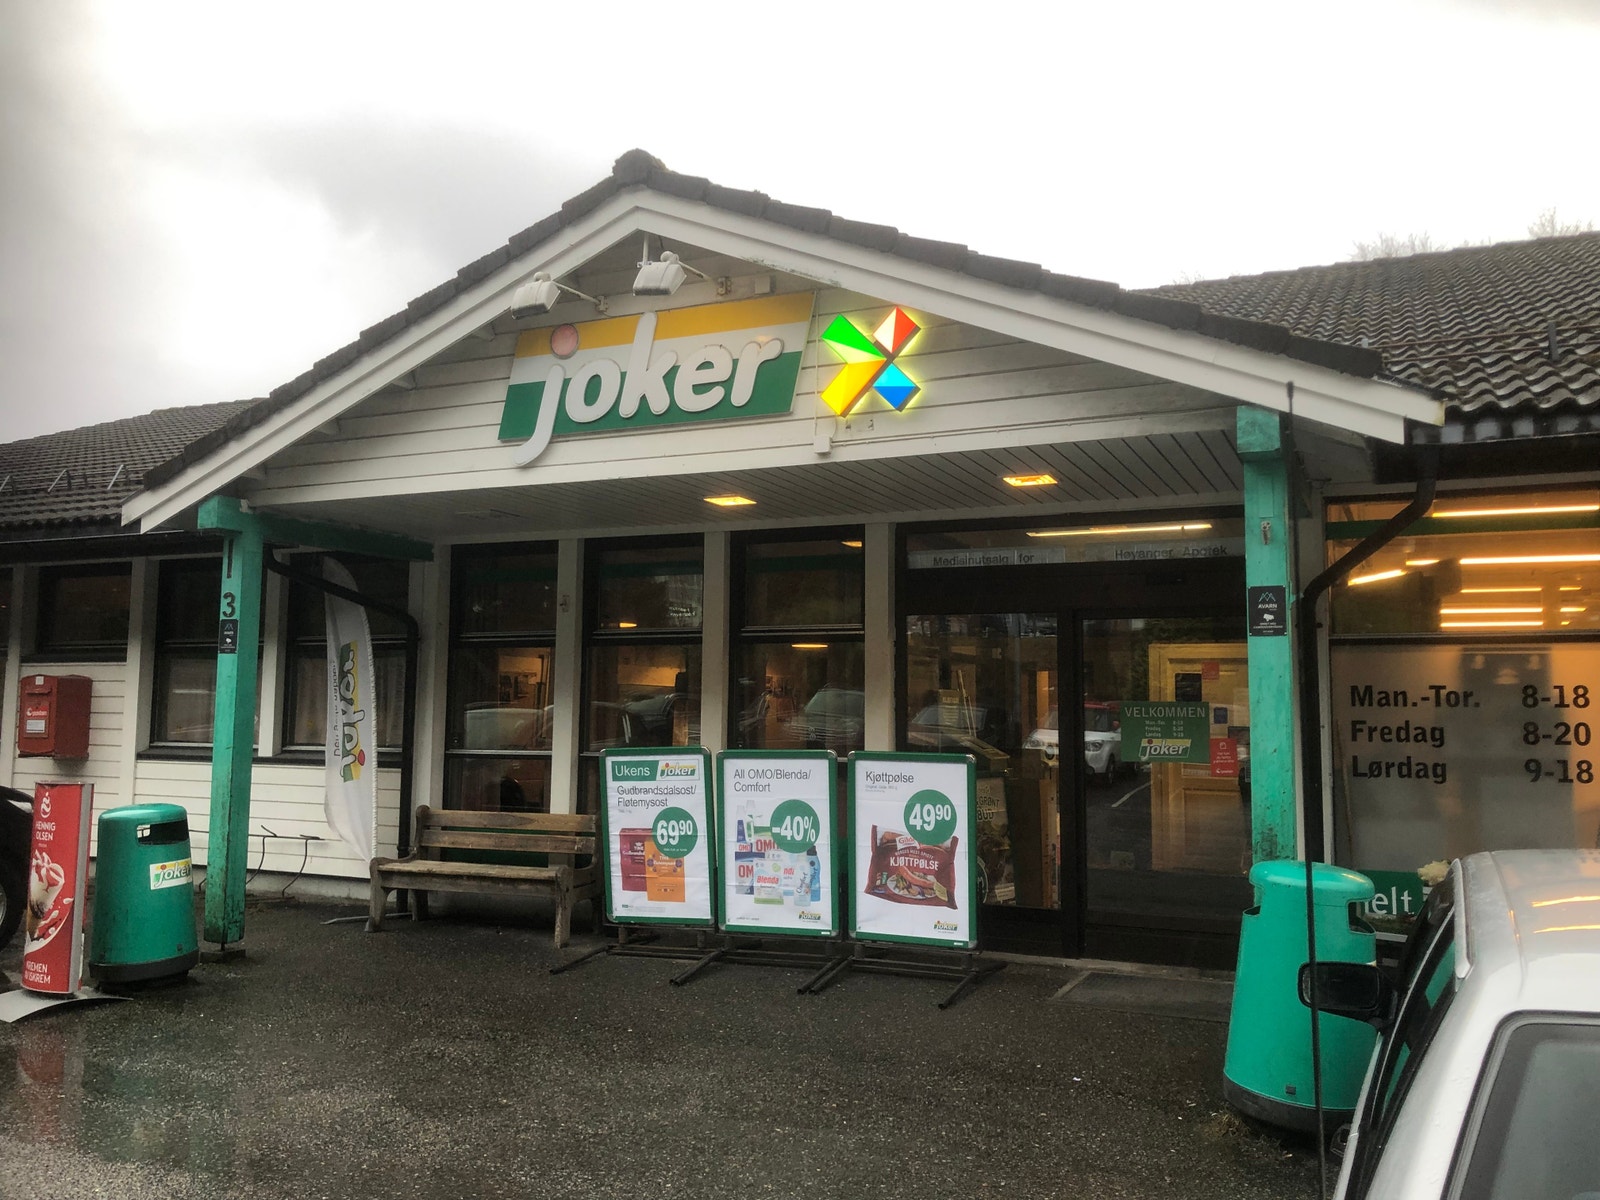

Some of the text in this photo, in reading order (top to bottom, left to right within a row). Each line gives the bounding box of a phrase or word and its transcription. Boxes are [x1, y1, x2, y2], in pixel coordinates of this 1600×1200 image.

[511, 311, 784, 467] joker
[933, 554, 1009, 567] Medisinutsalg
[1018, 552, 1034, 564] for
[1182, 544, 1228, 558] Apotek
[222, 591, 236, 618] 3
[1350, 684, 1590, 709] Man.-Tor. 8-18
[1124, 706, 1206, 718] VELKOMMEN
[1351, 720, 1592, 748] Fredag 8-20
[1141, 739, 1187, 761] joker
[615, 765, 651, 777] Ukens
[661, 762, 694, 780] joker
[733, 769, 812, 780] All OMO/Blenda/
[1352, 755, 1594, 784] Lørdag 9-18
[865, 771, 914, 785] Kjøttpølse
[617, 785, 697, 796] Gudbrandsdalsost/
[733, 782, 771, 792] Comfort
[617, 797, 668, 810] Fløtemysost
[35, 831, 54, 841] OLSEN
[772, 815, 816, 842] -40%
[890, 856, 939, 870] KJØTTPØLSE
